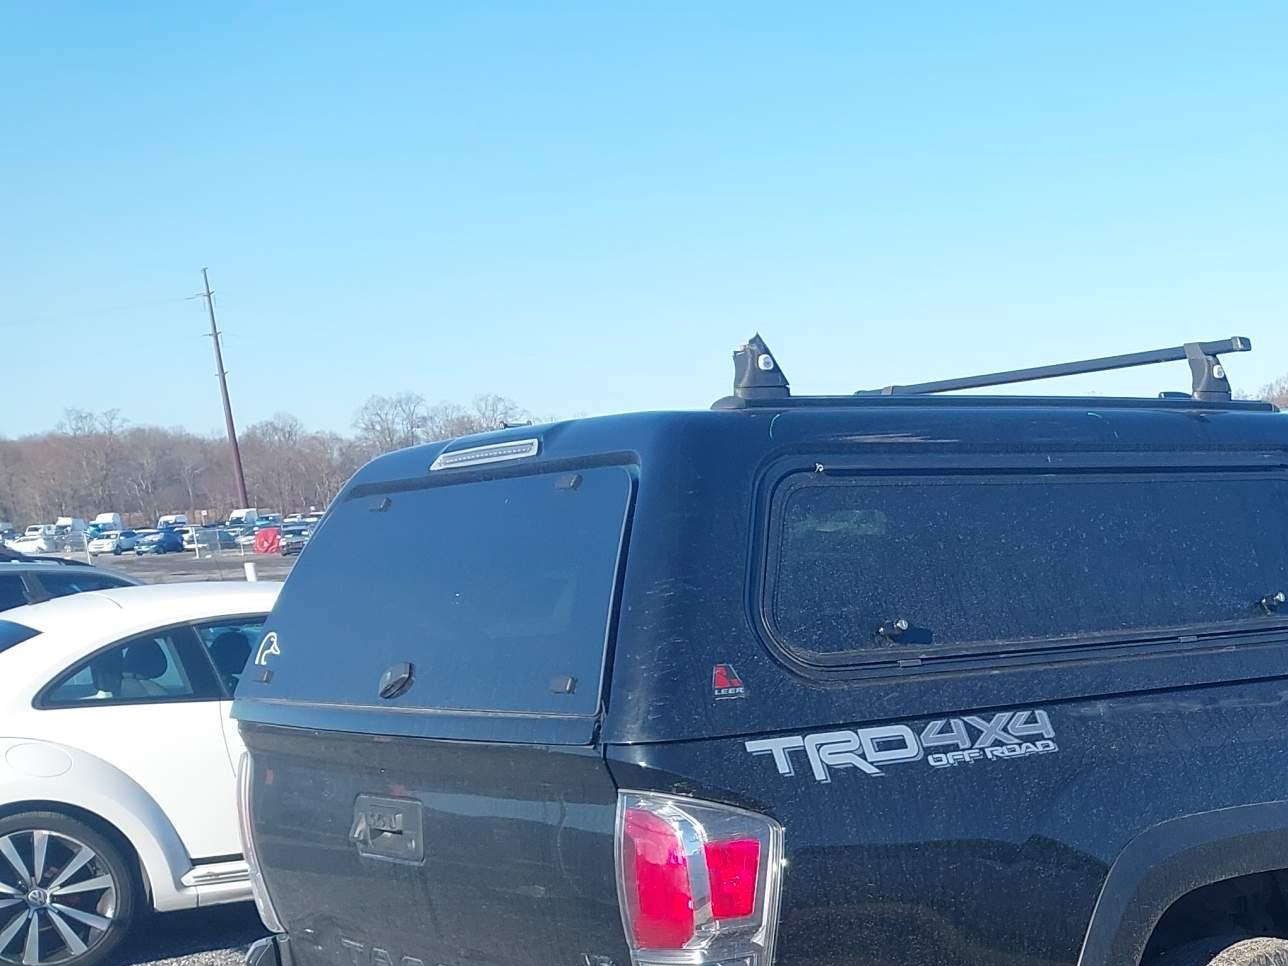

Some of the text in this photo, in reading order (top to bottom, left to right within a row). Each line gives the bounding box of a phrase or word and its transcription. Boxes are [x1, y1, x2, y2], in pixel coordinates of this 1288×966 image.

[714, 687, 745, 696] LEER
[745, 723, 924, 784] TRD
[927, 739, 1059, 769] OFF ROAD
